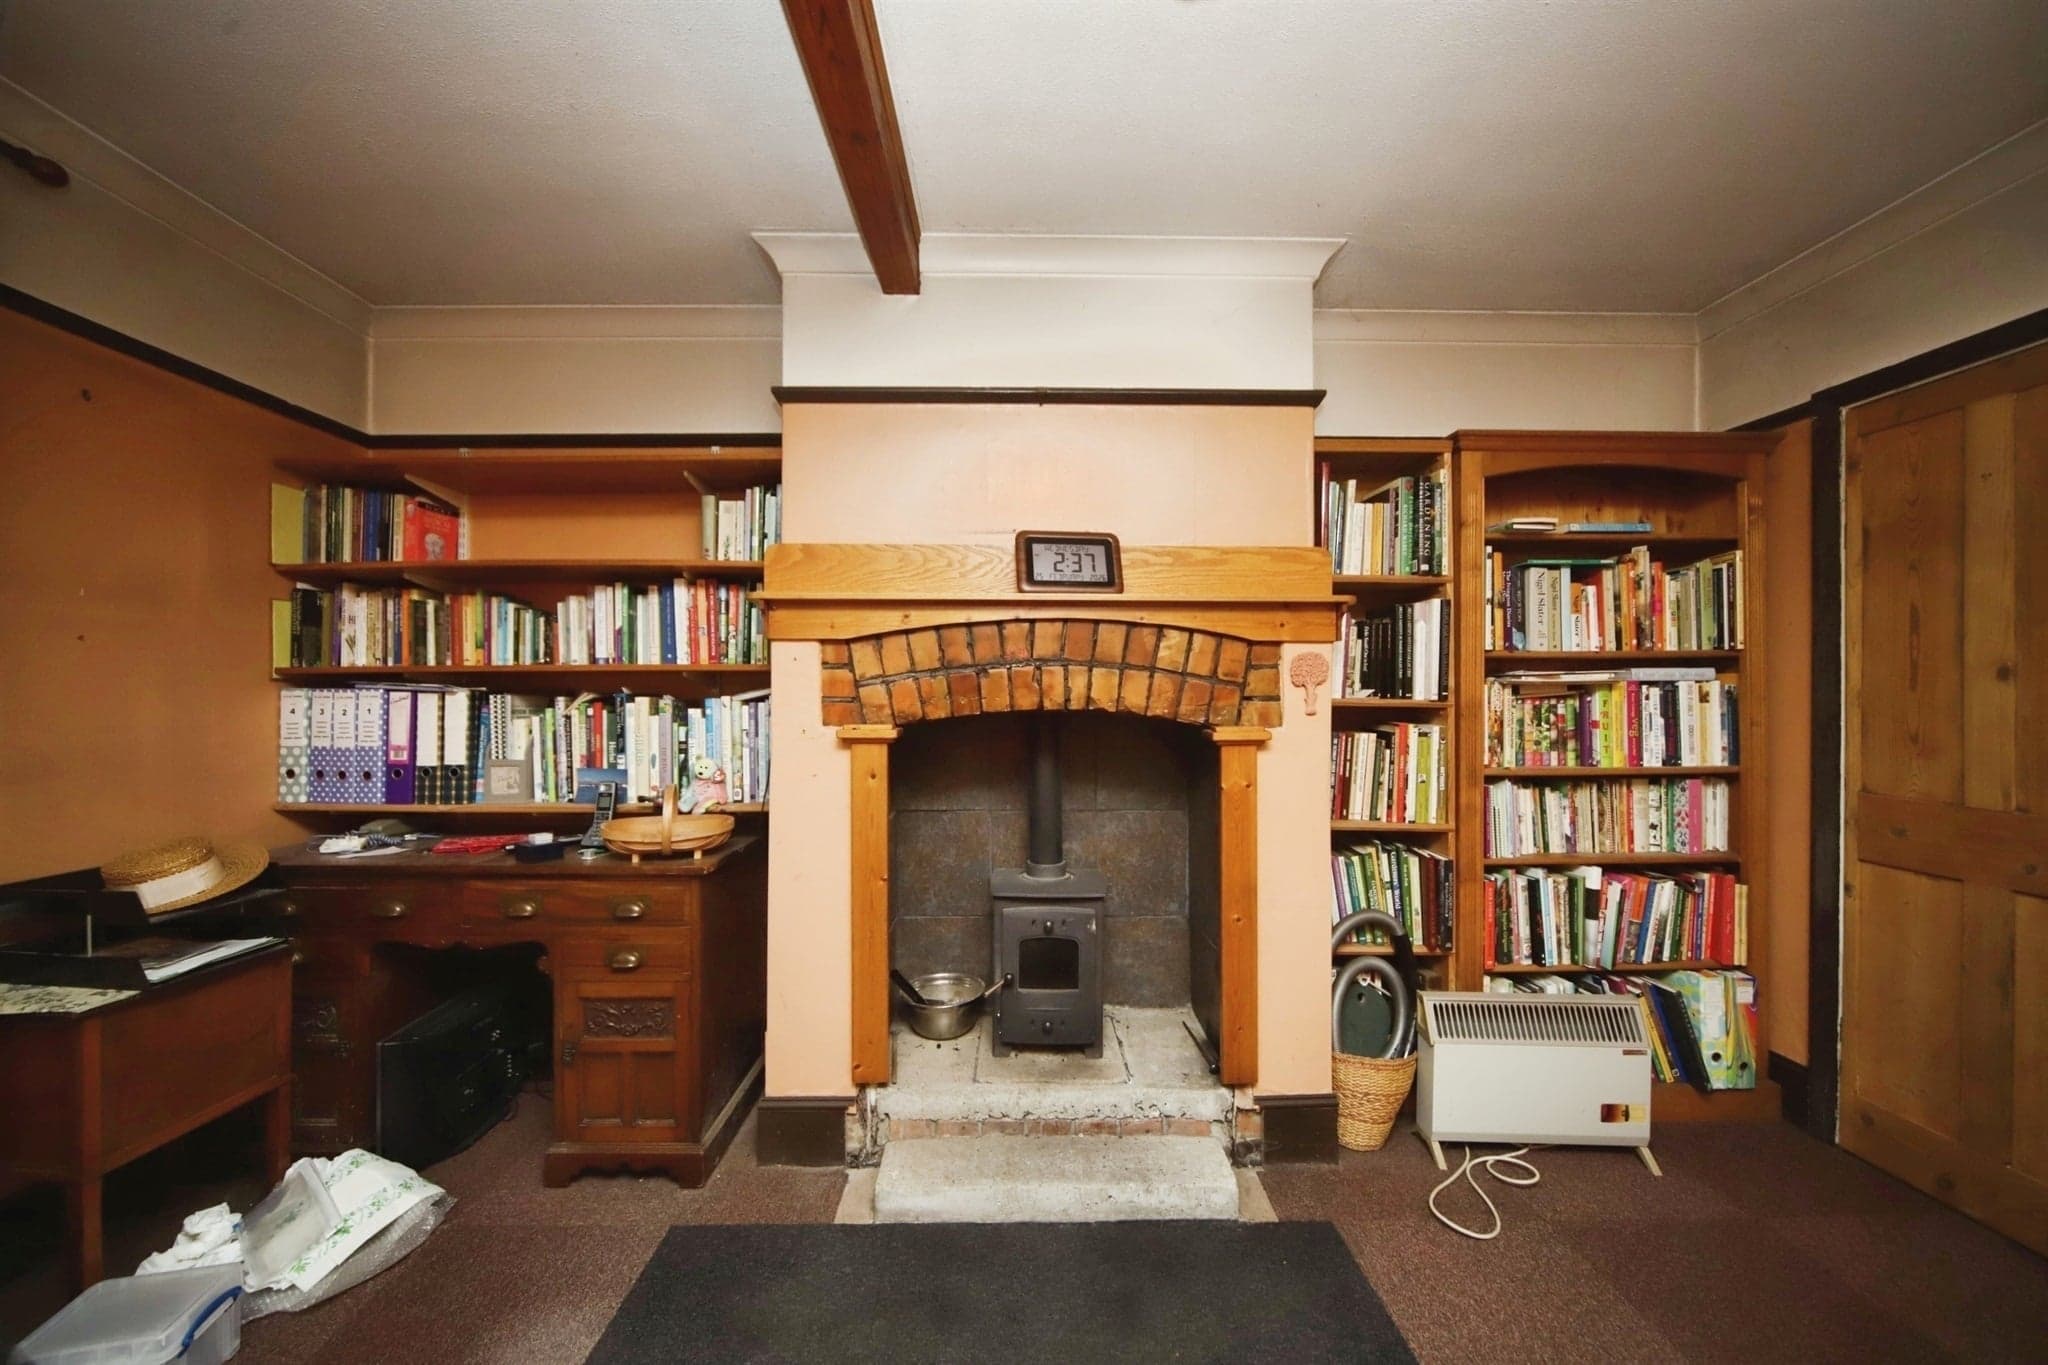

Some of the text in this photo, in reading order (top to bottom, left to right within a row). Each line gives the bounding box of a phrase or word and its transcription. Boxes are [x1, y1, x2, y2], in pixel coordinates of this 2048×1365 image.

[1423, 481, 1432, 557] GARDENING
[1053, 552, 1097, 572] 2:37
[1536, 571, 1546, 596] Nigel
[1537, 597, 1546, 625] Slater
[289, 707, 296, 715] 4
[319, 707, 325, 716] 3
[1601, 698, 1609, 754] FRUIT
[1628, 717, 1639, 737] veg
[1393, 889, 1401, 910] World
